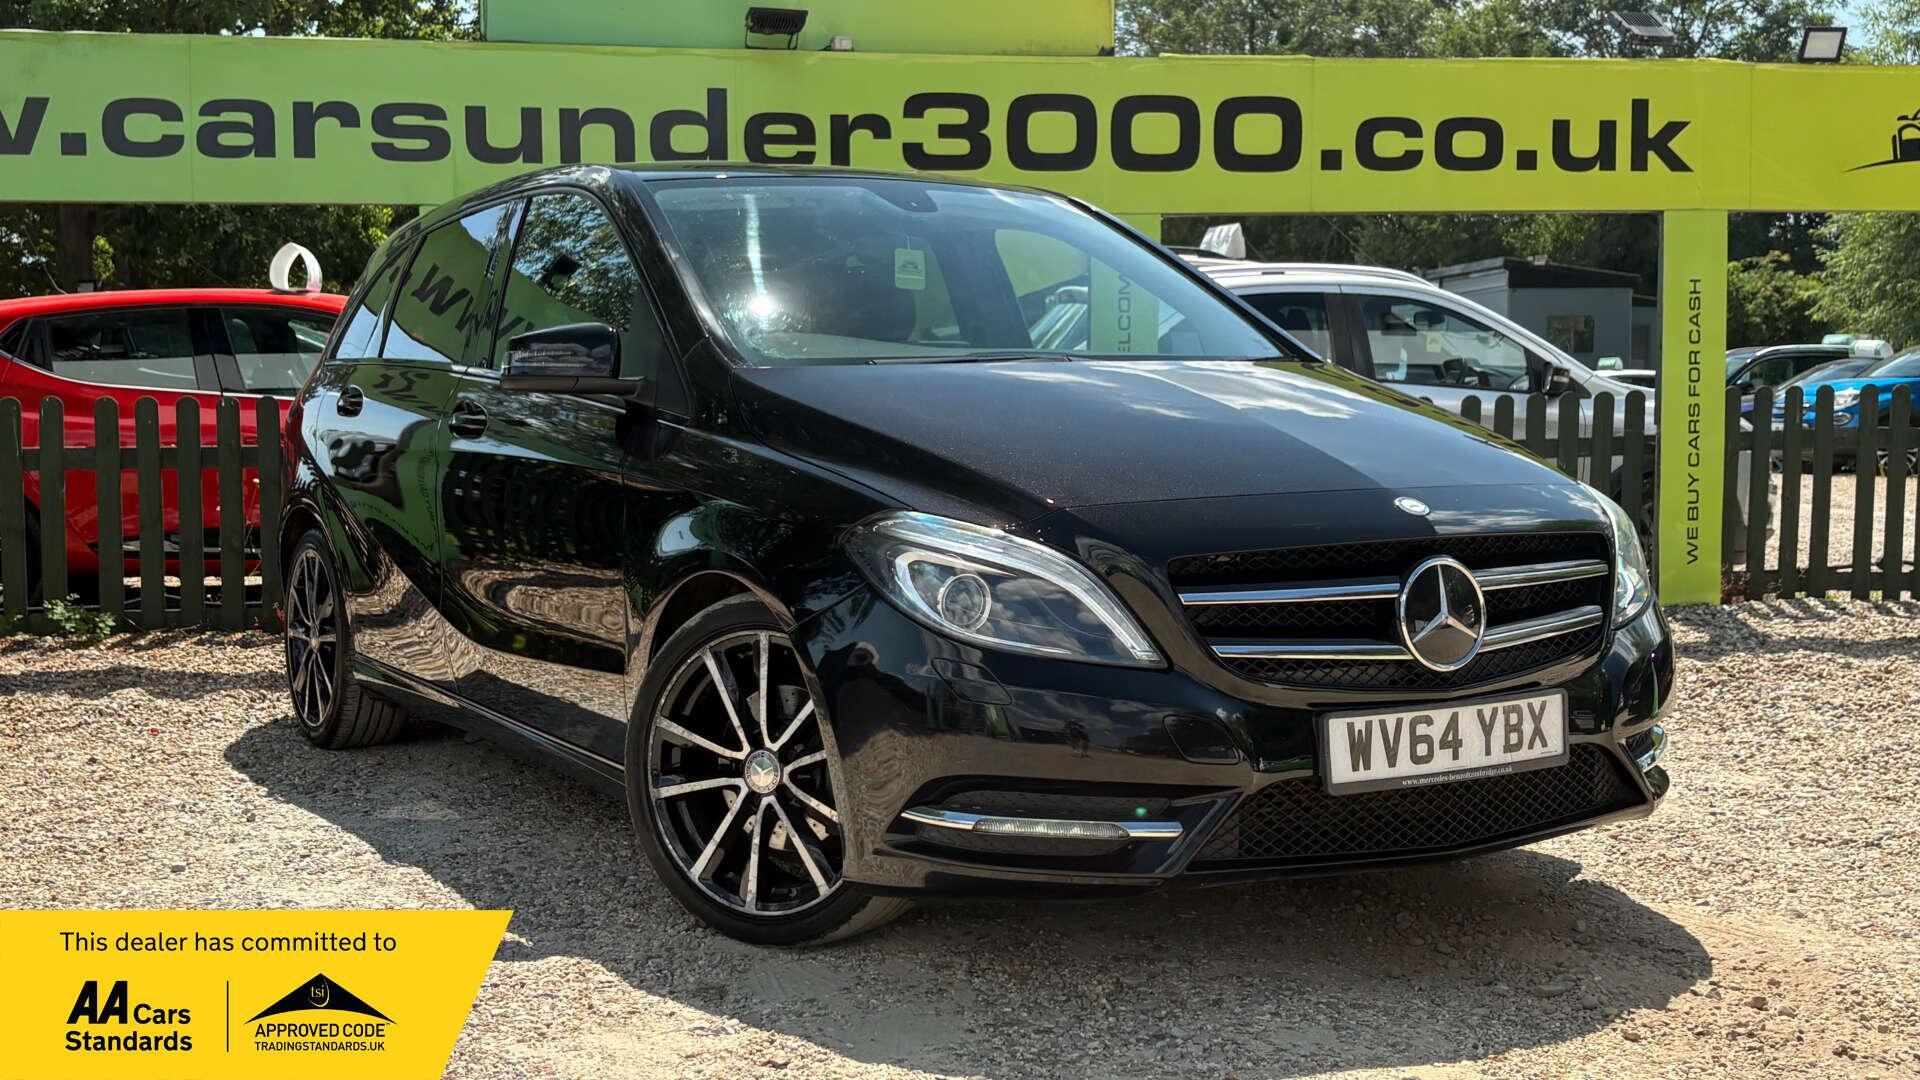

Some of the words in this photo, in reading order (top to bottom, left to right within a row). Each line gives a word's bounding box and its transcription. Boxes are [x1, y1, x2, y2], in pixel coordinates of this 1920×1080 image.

[1689, 279, 1701, 345] CASH
[1688, 350, 1701, 397] FOR
[1688, 403, 1700, 467] CARS
[1687, 473, 1700, 521] BUY
[1687, 526, 1699, 565] WE
[1347, 711, 1463, 772] WV64
[1476, 700, 1548, 756] YBX
